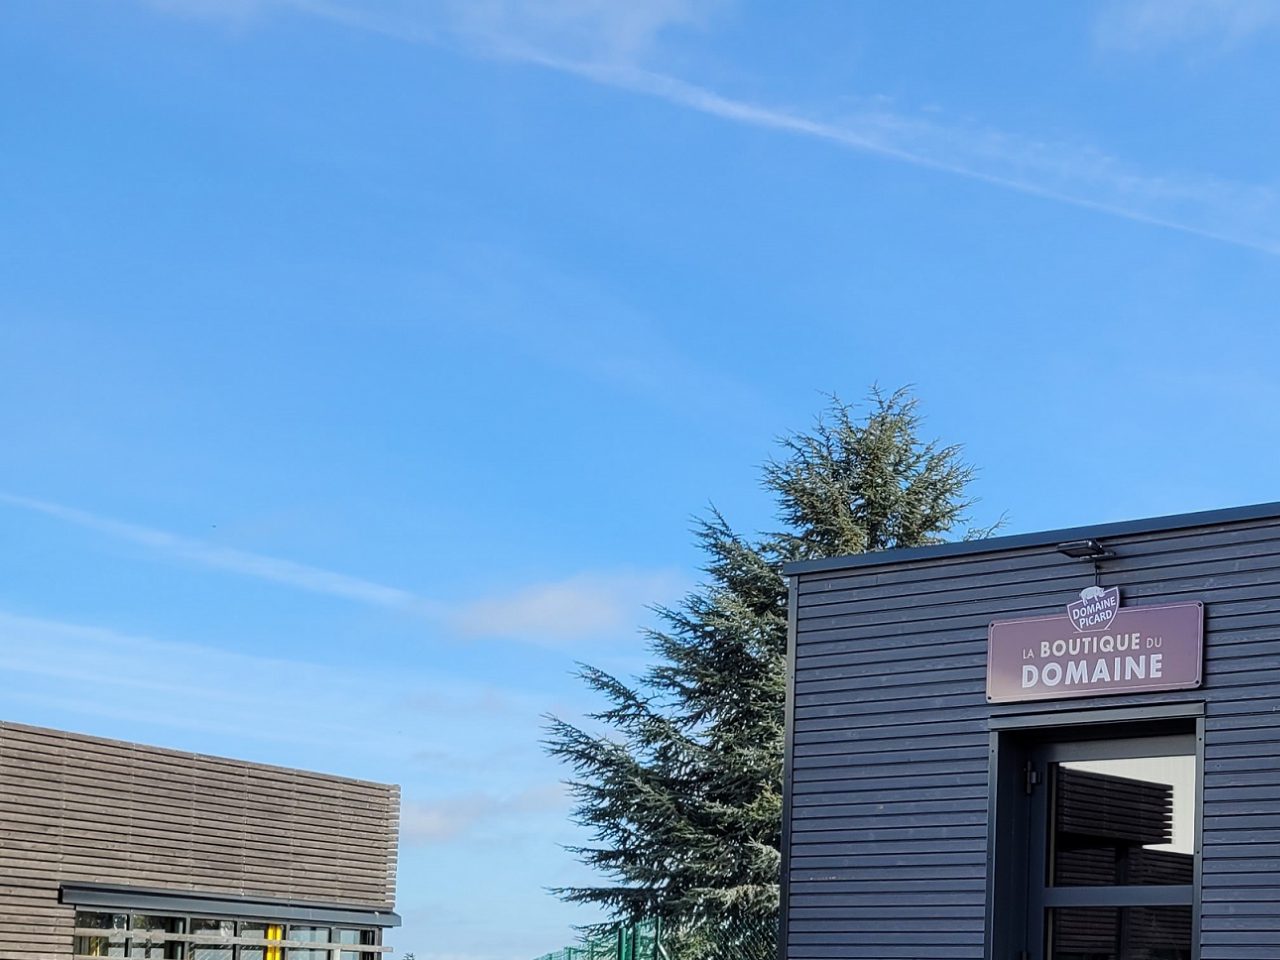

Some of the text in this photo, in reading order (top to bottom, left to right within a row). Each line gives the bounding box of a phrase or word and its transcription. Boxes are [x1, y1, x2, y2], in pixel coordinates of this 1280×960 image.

[1072, 596, 1116, 620] DOMAINE
[1079, 609, 1112, 629] PICARD
[1023, 633, 1162, 660] LA BOUTIQUE DU
[1022, 654, 1163, 688] DOMAINE
